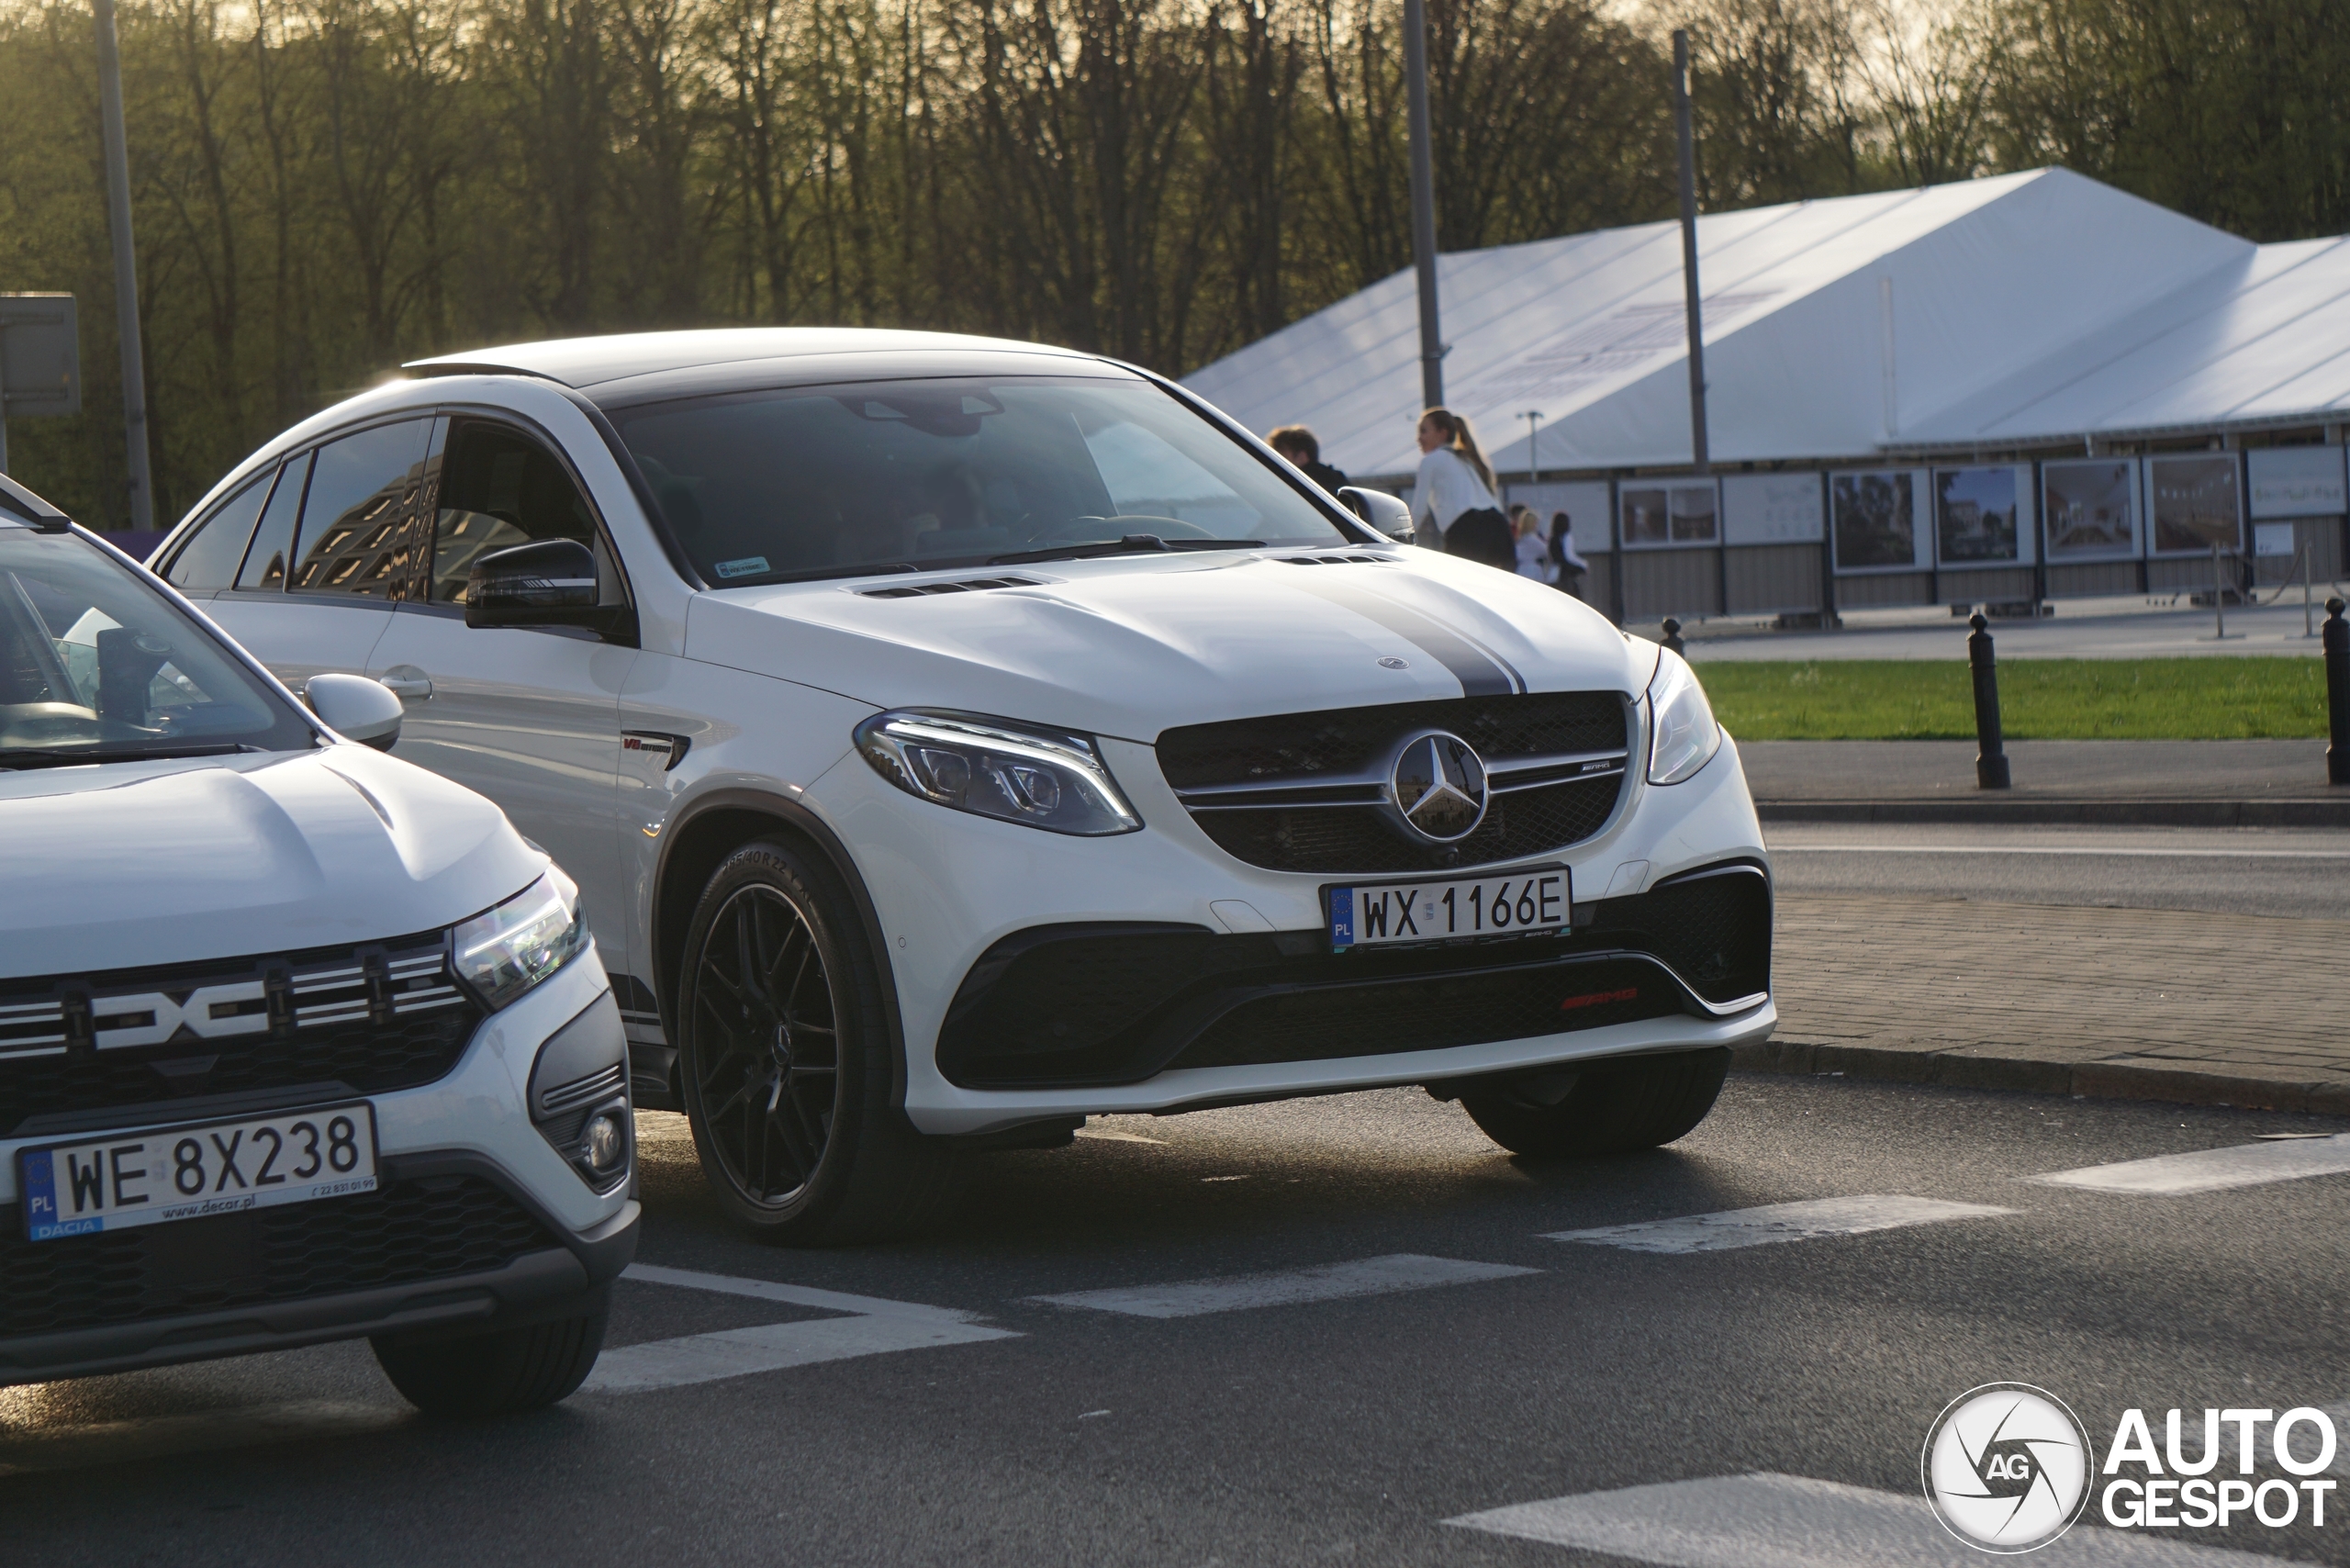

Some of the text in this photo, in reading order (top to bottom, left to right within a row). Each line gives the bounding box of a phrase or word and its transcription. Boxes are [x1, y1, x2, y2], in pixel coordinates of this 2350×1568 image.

[624, 738, 641, 750] V8
[762, 852, 771, 866] R
[772, 857, 787, 874] 22
[1363, 876, 1561, 938] WX 1166E
[1335, 924, 1351, 936] PL
[68, 1115, 359, 1214] WE 8X238
[31, 1196, 53, 1215] PL
[162, 1194, 256, 1220] www.decar.pl
[39, 1221, 95, 1238] DACIA
